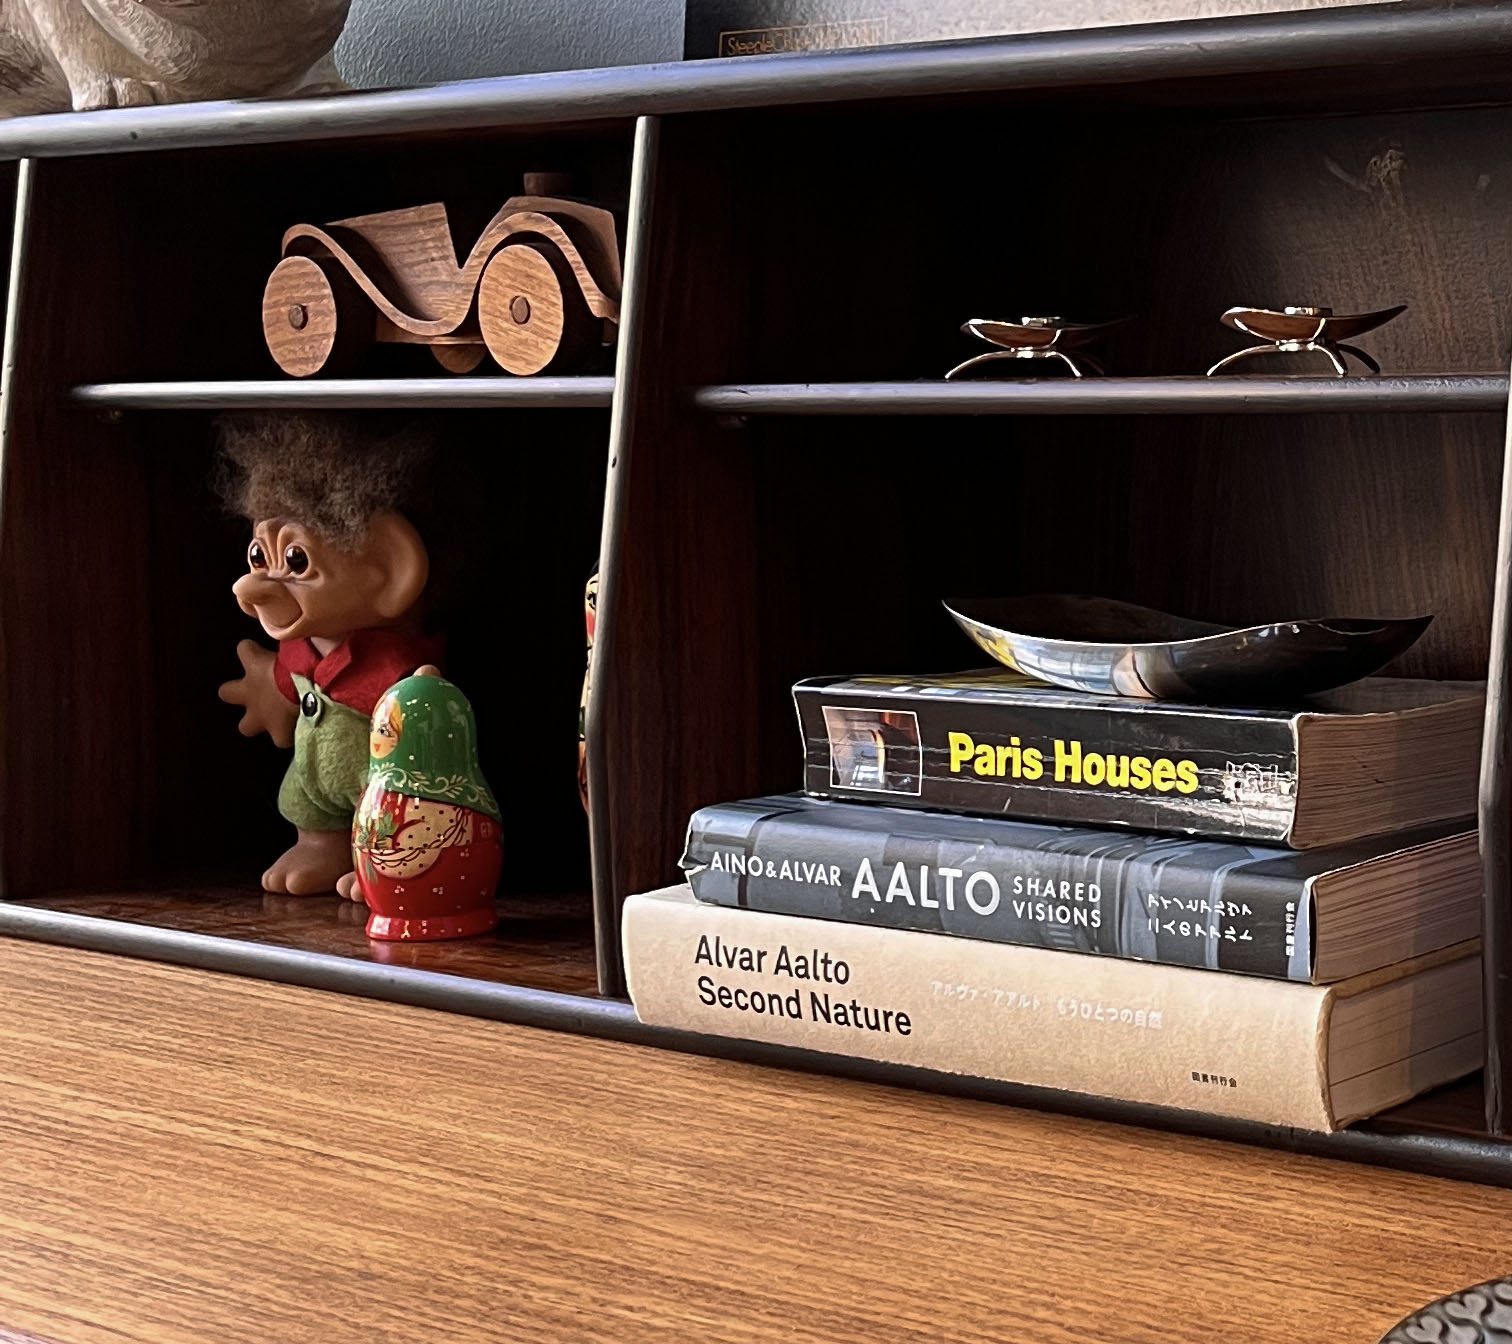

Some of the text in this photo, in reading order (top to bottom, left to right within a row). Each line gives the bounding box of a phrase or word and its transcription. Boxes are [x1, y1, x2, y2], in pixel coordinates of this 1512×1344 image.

[947, 730, 1200, 795] Paris Houses
[710, 850, 1001, 916] AINO&ALVAR AALTO
[1012, 875, 1102, 903] SHARED
[1012, 900, 1102, 928] VISIONS
[694, 934, 850, 985] Alvar Aalto
[697, 975, 912, 1036] Second Nature
